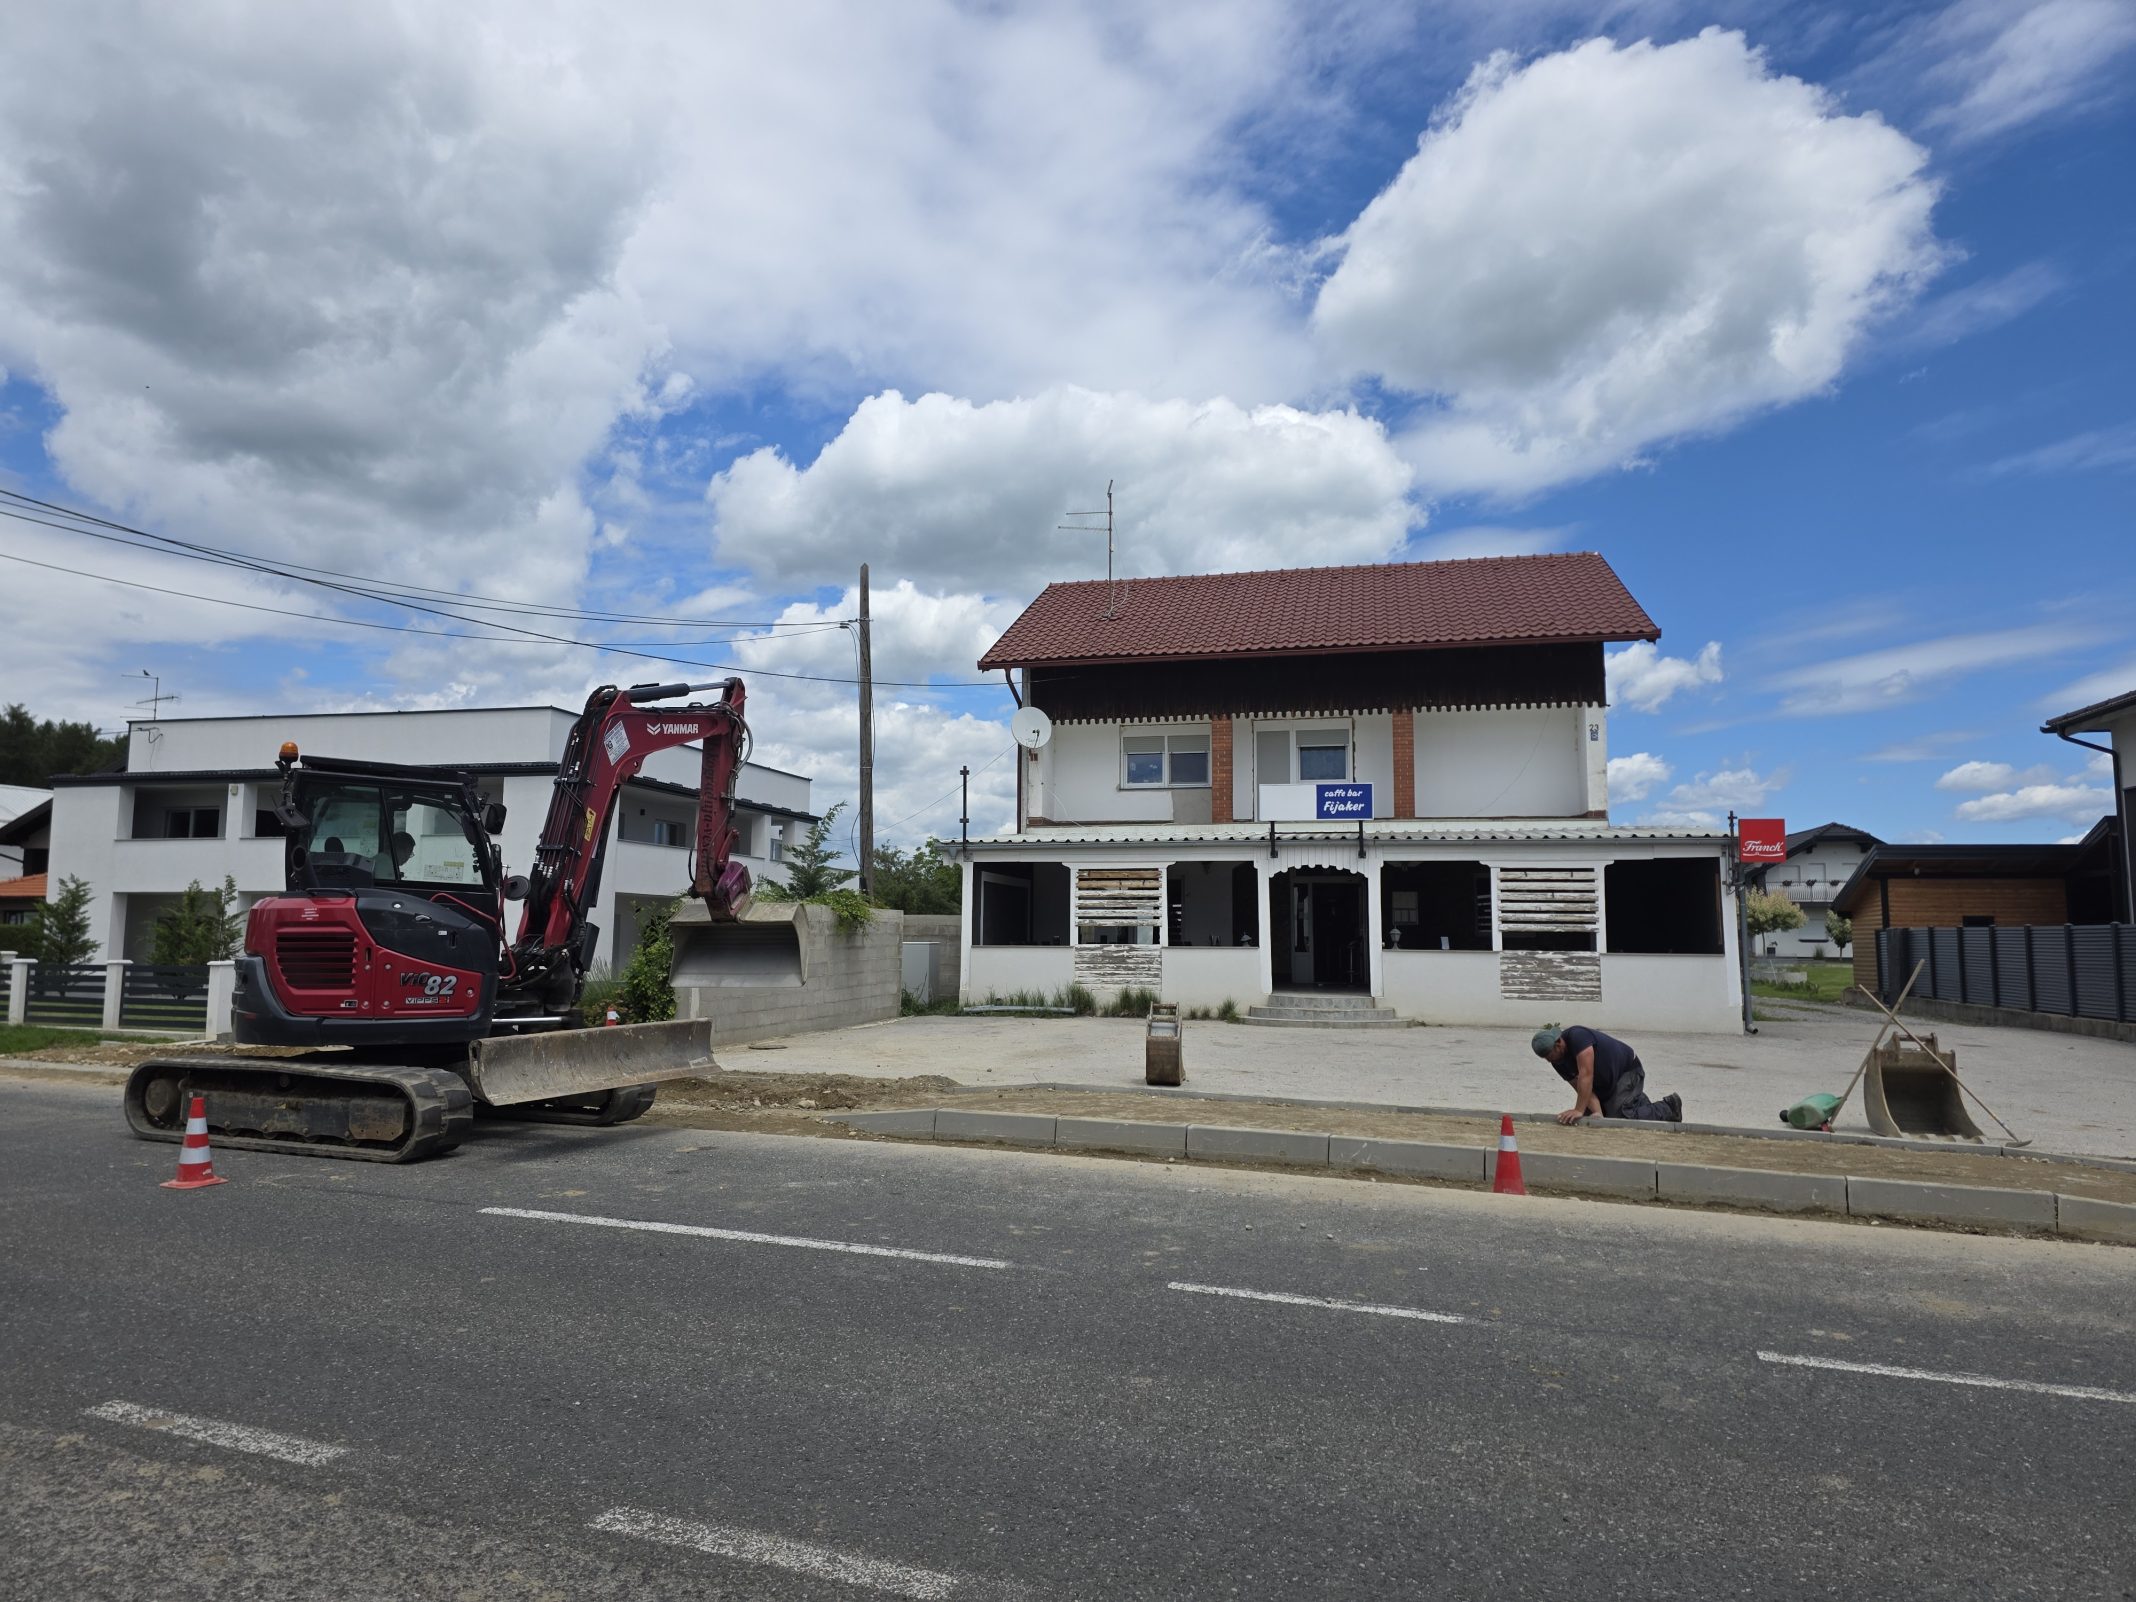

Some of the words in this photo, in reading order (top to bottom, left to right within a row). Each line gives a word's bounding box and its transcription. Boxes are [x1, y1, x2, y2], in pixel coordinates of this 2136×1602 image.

[662, 723, 699, 735] YANMAR
[1324, 789, 1346, 797] caffe
[1347, 788, 1363, 797] bar
[1323, 800, 1365, 815] Fijaker
[1742, 840, 1784, 852] Franck
